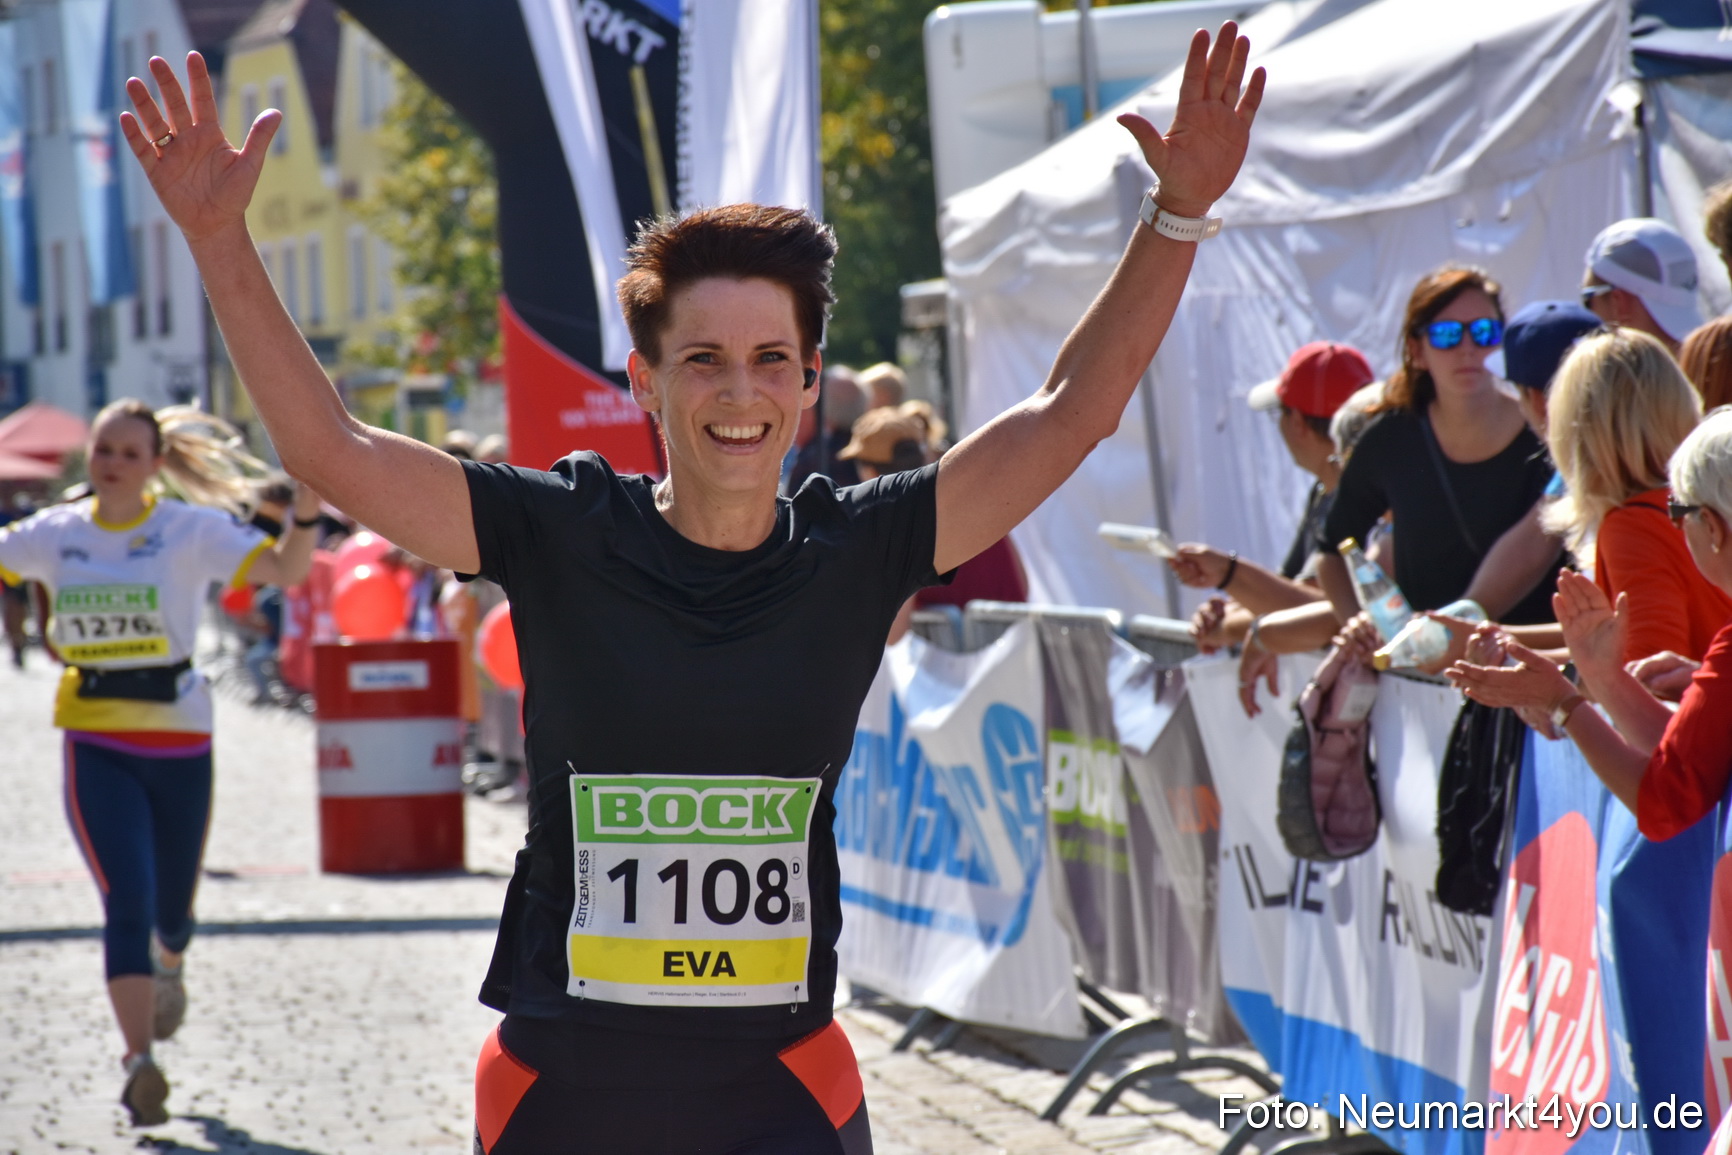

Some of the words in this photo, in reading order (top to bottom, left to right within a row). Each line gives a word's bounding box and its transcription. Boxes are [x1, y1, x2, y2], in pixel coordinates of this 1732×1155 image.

[69, 614, 152, 638] 1276
[594, 788, 794, 835] BOCK
[792, 862, 800, 875] D
[607, 857, 791, 926] 1108
[663, 951, 737, 978] EVA
